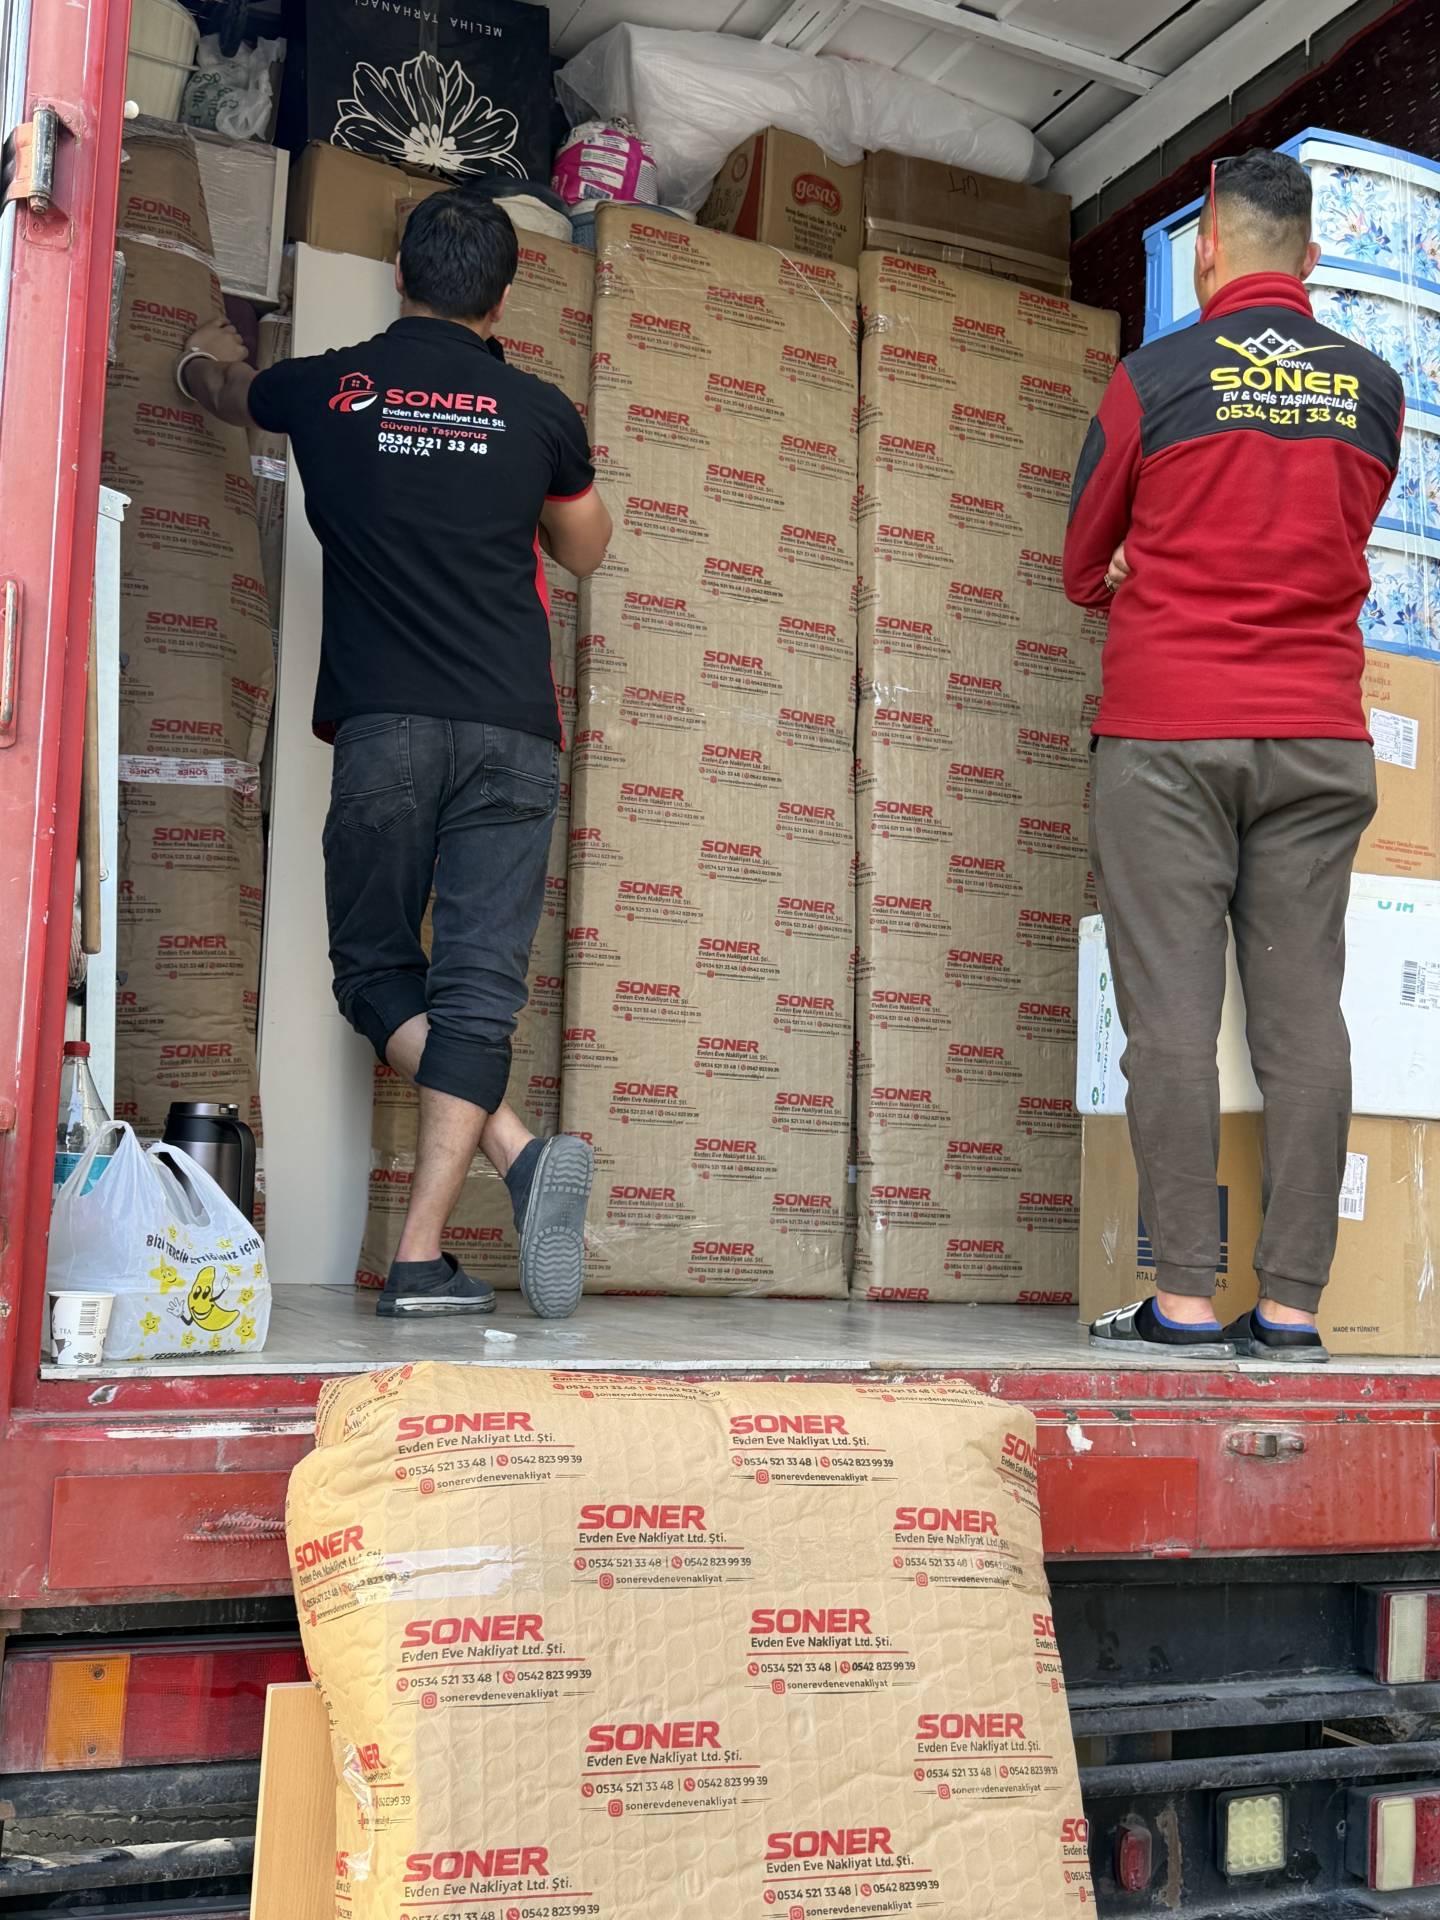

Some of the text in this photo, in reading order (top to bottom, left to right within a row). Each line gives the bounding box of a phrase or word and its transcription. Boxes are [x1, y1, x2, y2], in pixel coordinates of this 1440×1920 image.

[127, 196, 191, 226] SONER
[631, 223, 690, 246] SONER
[882, 255, 937, 278] SONER
[132, 299, 198, 326] SONER
[631, 311, 691, 333] SONER
[953, 316, 1004, 336] SONER
[881, 345, 937, 366] SONER
[1277, 358, 1313, 371] KONYA
[708, 373, 766, 395] SONER
[1020, 376, 1072, 394] SONER
[1210, 367, 1359, 400] SONER
[385, 389, 498, 414] SONER
[1223, 391, 1238, 402] EV
[1241, 391, 1250, 400] &
[137, 402, 205, 427] SONER
[382, 408, 411, 417] Evden
[413, 411, 430, 419] Eve
[472, 416, 490, 426] Ltd.
[953, 402, 1007, 423] SONER
[1216, 404, 1357, 429] 0534 521 33 48
[380, 421, 488, 440] Güvenle Taşıyoruz
[378, 432, 488, 455] 0534 521 33 48
[378, 443, 430, 457] KONYA
[783, 435, 837, 456] SONER
[880, 435, 937, 453] SONER
[708, 464, 767, 485] SONER
[627, 496, 688, 516] SONER
[950, 492, 1005, 511] SONER
[140, 506, 211, 530] SONER
[782, 525, 837, 545] SONER
[705, 557, 764, 576] SONER
[949, 581, 1004, 601] SONER
[626, 592, 687, 610] SONER
[146, 611, 218, 630] SONER
[876, 616, 932, 635] SONER
[704, 650, 763, 669] SONER
[779, 708, 836, 726] SONER
[150, 718, 224, 736] SONER
[949, 763, 1004, 779] SONER
[621, 784, 684, 800] SONER
[153, 826, 226, 842] SONER
[949, 855, 1004, 870] SONER
[619, 880, 682, 898] SONER
[778, 896, 835, 913] SONER
[874, 896, 932, 912] SONER
[158, 935, 227, 949] SONER
[948, 949, 1003, 965] SONER
[617, 980, 681, 997] SONER
[875, 991, 932, 1006] SONER
[160, 1043, 232, 1059] SONER
[698, 1036, 759, 1052] SONER
[949, 1043, 1004, 1058] SONER
[613, 1082, 678, 1098] SONER
[873, 1088, 931, 1102] SONER
[696, 1138, 756, 1153] SONER
[395, 1411, 534, 1442] SONER
[730, 1415, 847, 1435] SONER
[398, 1432, 556, 1454] Evden Eve Nakliyat Ltd. Şti.
[732, 1435, 870, 1449] Evden Eve Nakliyat Ltd. Şti.
[744, 1456, 812, 1466] 0534 521 33 48
[437, 1470, 551, 1488] sonerevdenevenakliyat
[771, 1472, 868, 1484] sonerevdenevenakliyat
[578, 1504, 704, 1530] SONER
[895, 1507, 997, 1536] SONER
[579, 1531, 726, 1544] Evden Eve Nakliyat Ltd. Şti.
[295, 1525, 364, 1572] SONER
[616, 1574, 722, 1584] sonerevdenevenakliyat
[750, 1608, 871, 1634] SONER
[401, 1614, 544, 1648] SONER
[751, 1635, 892, 1649] Evden Eve Nakliyat Ltd. Şti.
[402, 1642, 565, 1663] Evden Eve Nakliyat Ltd. Şti.
[760, 1662, 831, 1672] 0534 521 33 48
[787, 1678, 888, 1691] sonerevdenevenakliyat
[915, 1713, 1024, 1740] SONER
[585, 1720, 720, 1753] SONER
[587, 1749, 741, 1766] Evden Eve Nakliyat Ltd. Şti.
[764, 1827, 892, 1860] SONER
[403, 1846, 548, 1883] SONER
[766, 1854, 914, 1873] Evden Eve Nakliyat Ltd. Şti.
[405, 1876, 572, 1897] Evden Eve Nakliyat Ltd. Şti.
